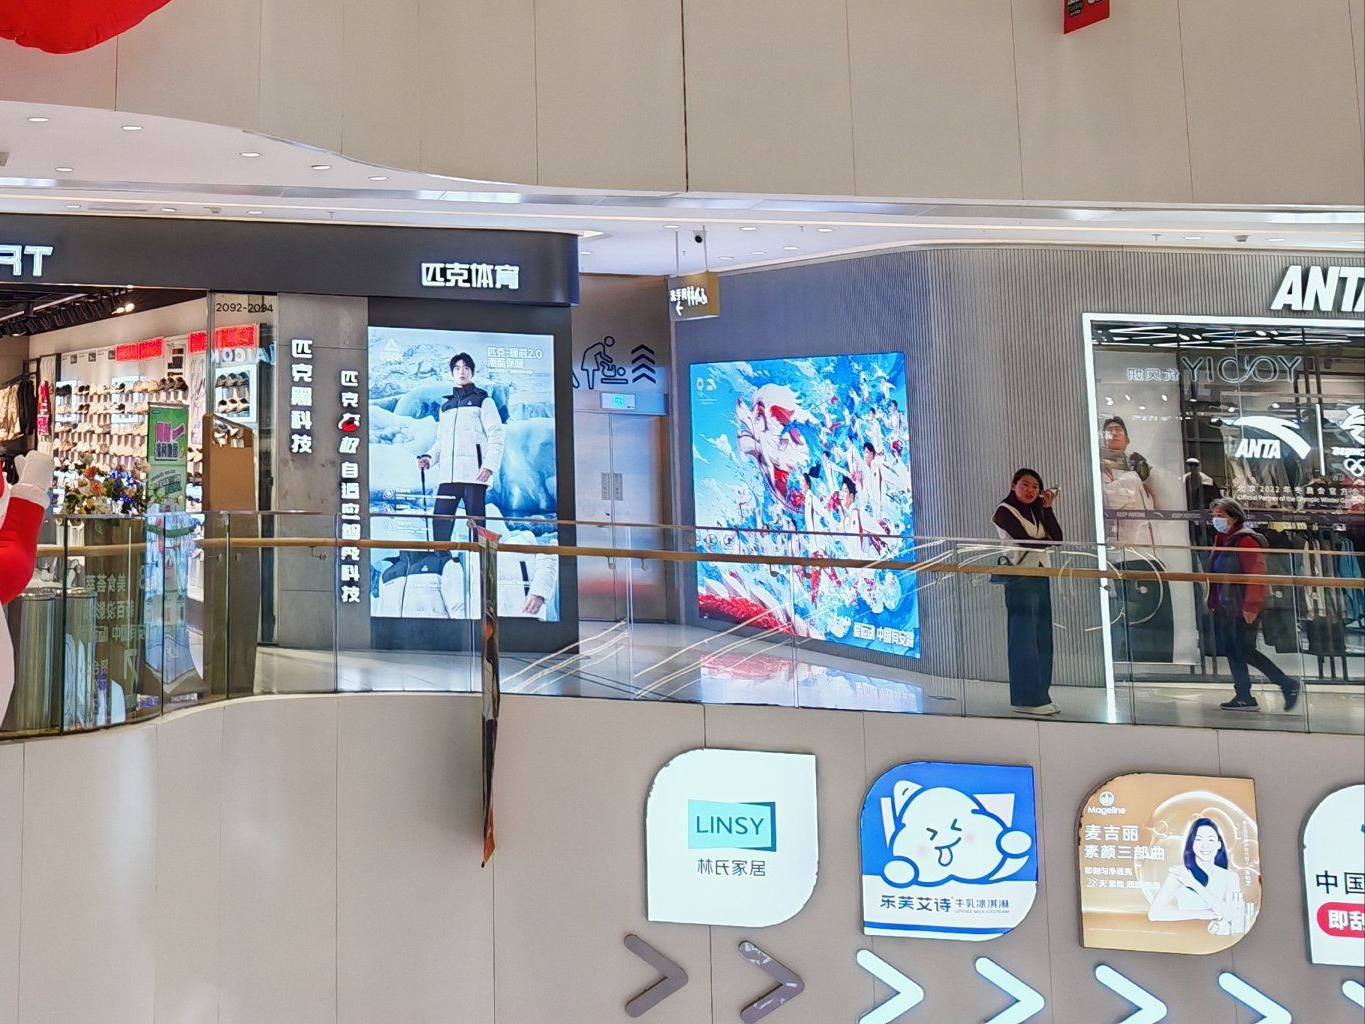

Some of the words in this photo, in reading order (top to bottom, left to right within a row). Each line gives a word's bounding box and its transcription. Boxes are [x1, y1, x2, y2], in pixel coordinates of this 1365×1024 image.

[421, 262, 521, 290] 匹克体育
[215, 302, 274, 313] 2092-2094
[290, 339, 313, 454] 匹克黑科技
[1235, 439, 1281, 459] ANTA
[1087, 807, 1127, 816] Mageline
[697, 815, 765, 835] LINSY
[1084, 824, 1139, 842] 麦吉丽
[1084, 844, 1165, 861] 素颜三部曲
[697, 858, 766, 877] 林氏家居
[1316, 869, 1365, 895] 中国
[880, 895, 952, 913] 乐芙艾诗
[955, 898, 1010, 909] 牛乳冰淇淋
